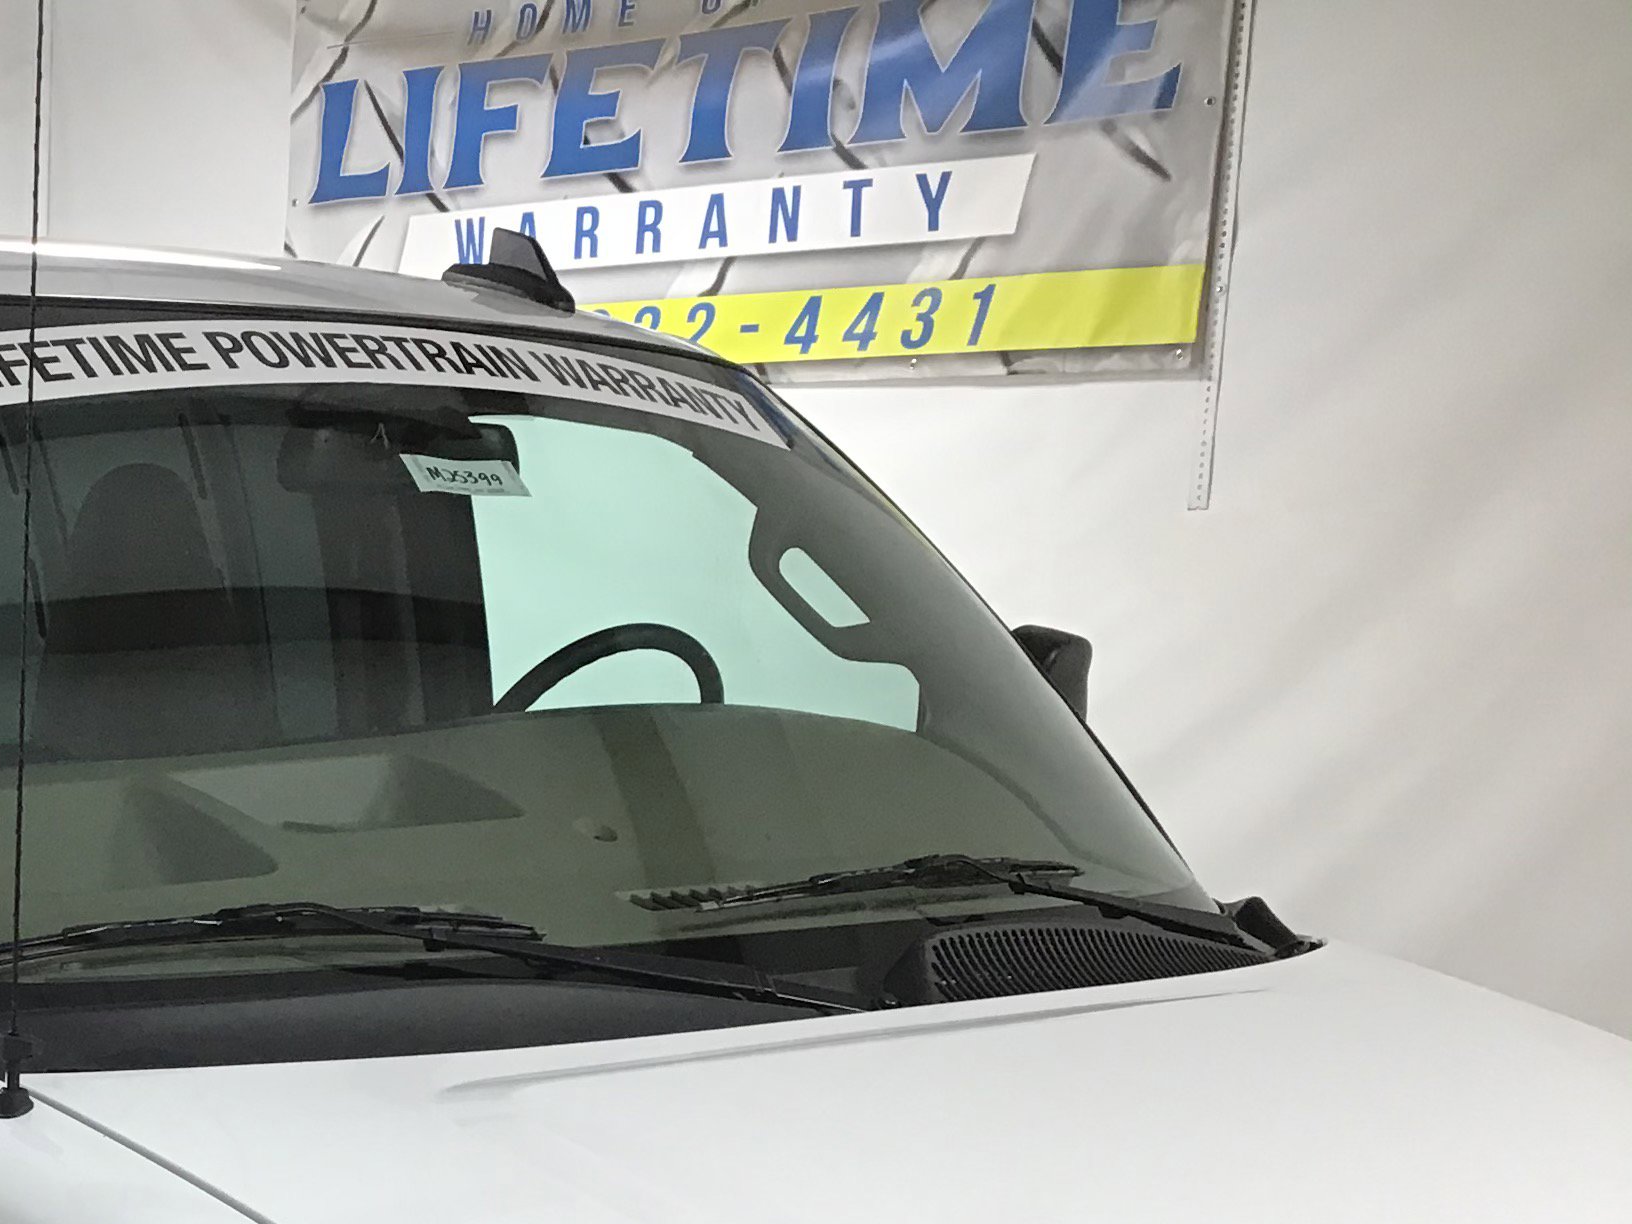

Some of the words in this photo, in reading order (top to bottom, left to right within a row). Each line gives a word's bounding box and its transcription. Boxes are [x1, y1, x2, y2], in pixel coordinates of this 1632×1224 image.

[468, 0, 637, 45] HOME
[308, 0, 1182, 206] LIFETIME
[202, 330, 541, 382] POWERTRAIN
[528, 350, 760, 432] WARRANTY
